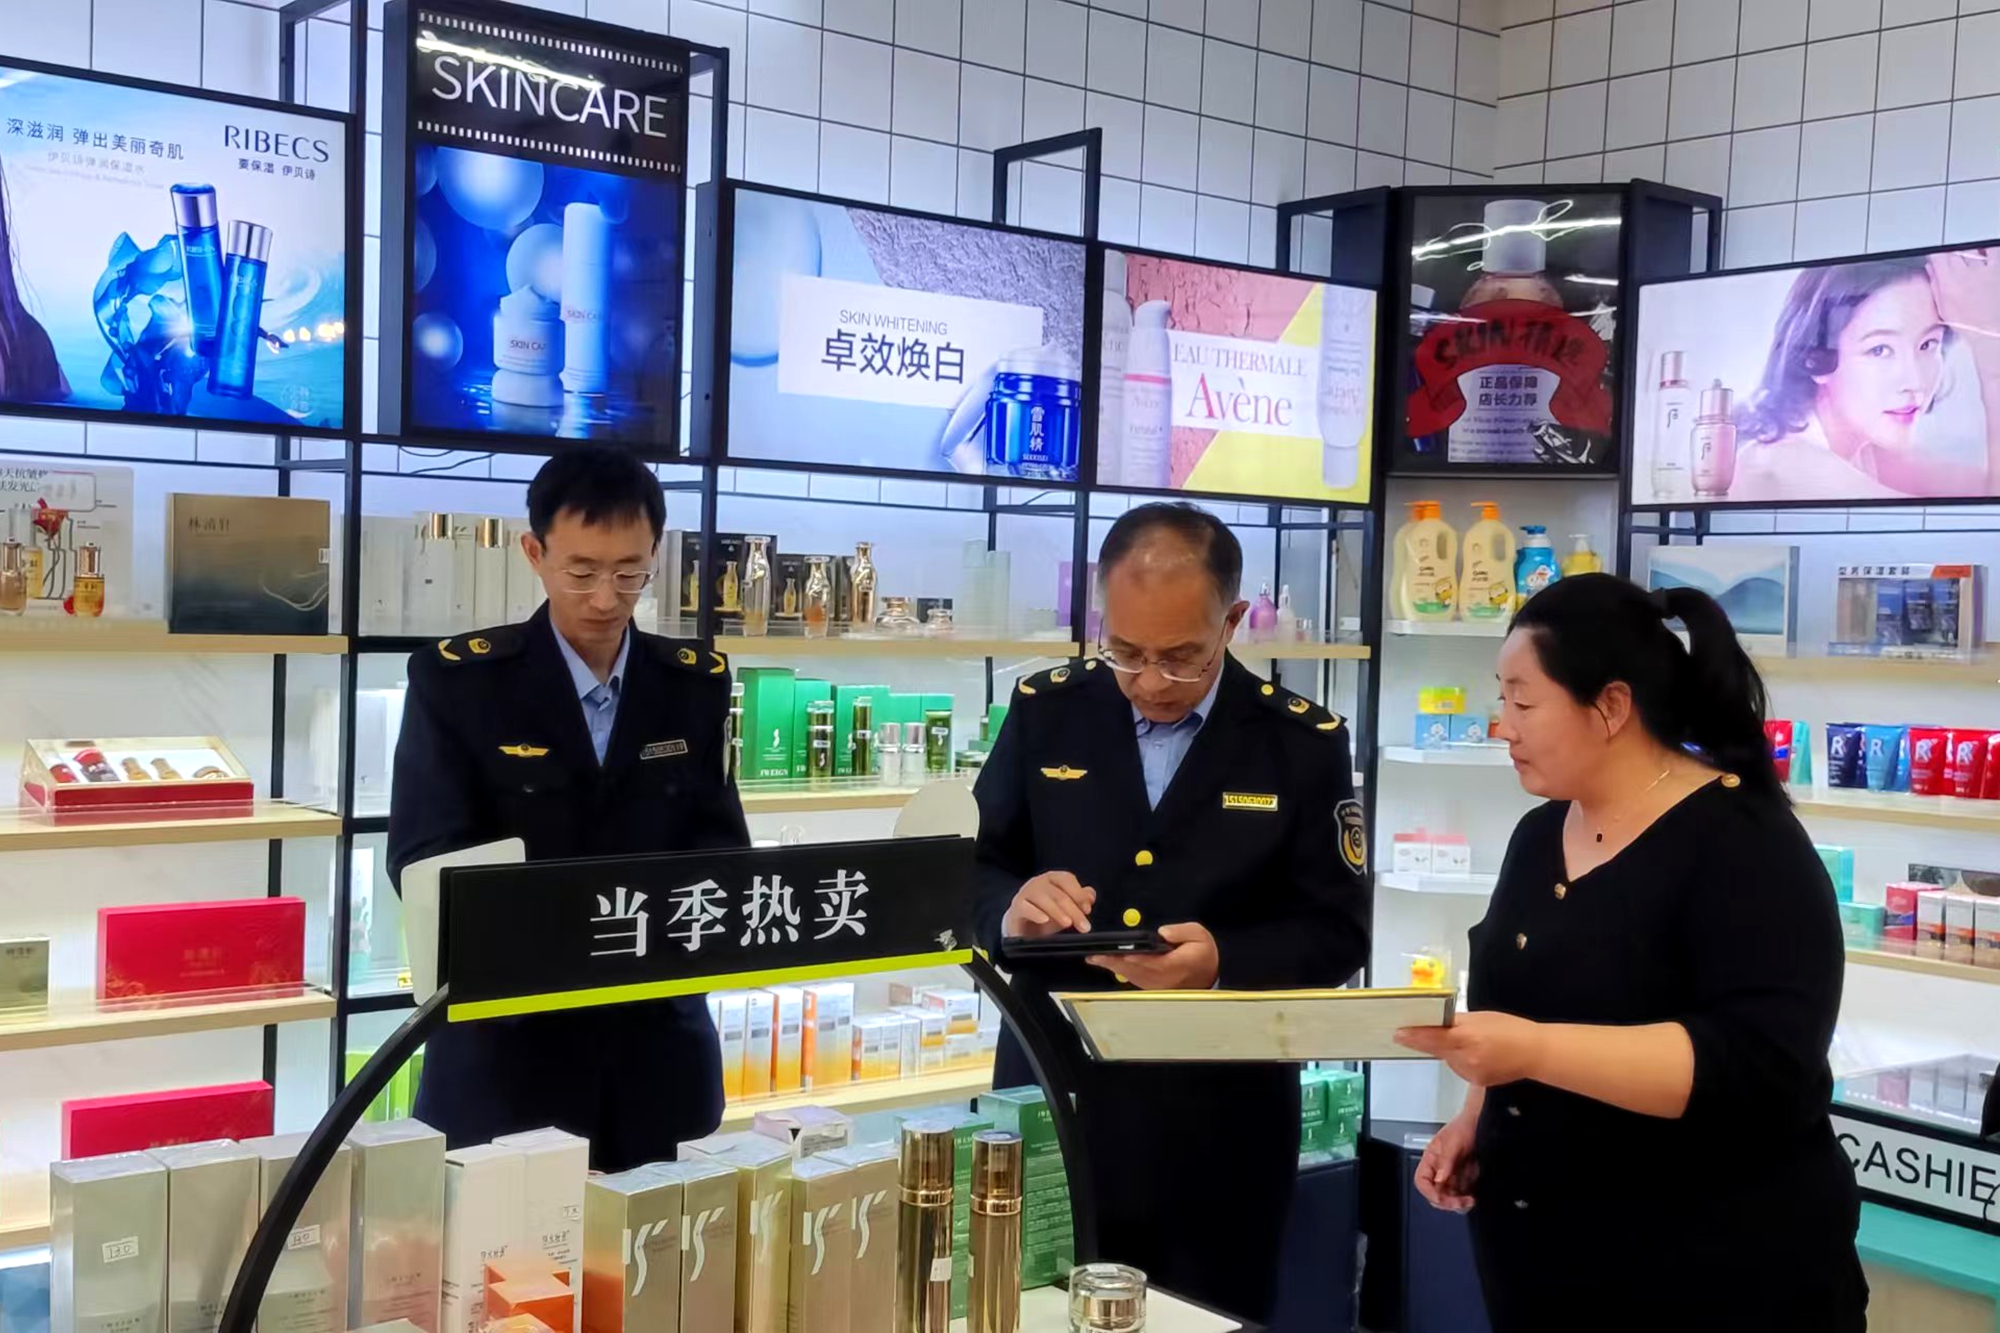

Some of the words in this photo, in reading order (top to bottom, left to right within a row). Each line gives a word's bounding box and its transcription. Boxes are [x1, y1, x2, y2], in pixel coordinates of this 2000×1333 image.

[432, 55, 667, 138] SKINCARE
[7, 117, 64, 142] 深滋润
[73, 128, 184, 160] 弹出美丽奇肌
[224, 125, 329, 163] RIBECS
[839, 309, 871, 326] SKIN
[874, 314, 948, 335] WHITENING
[511, 339, 530, 350] SKIN
[821, 328, 965, 385] 卓效焕白
[1174, 343, 1207, 364] EAU
[1213, 348, 1307, 377] THERMALE
[1186, 372, 1292, 427] Avène
[590, 869, 869, 957] 当季热卖
